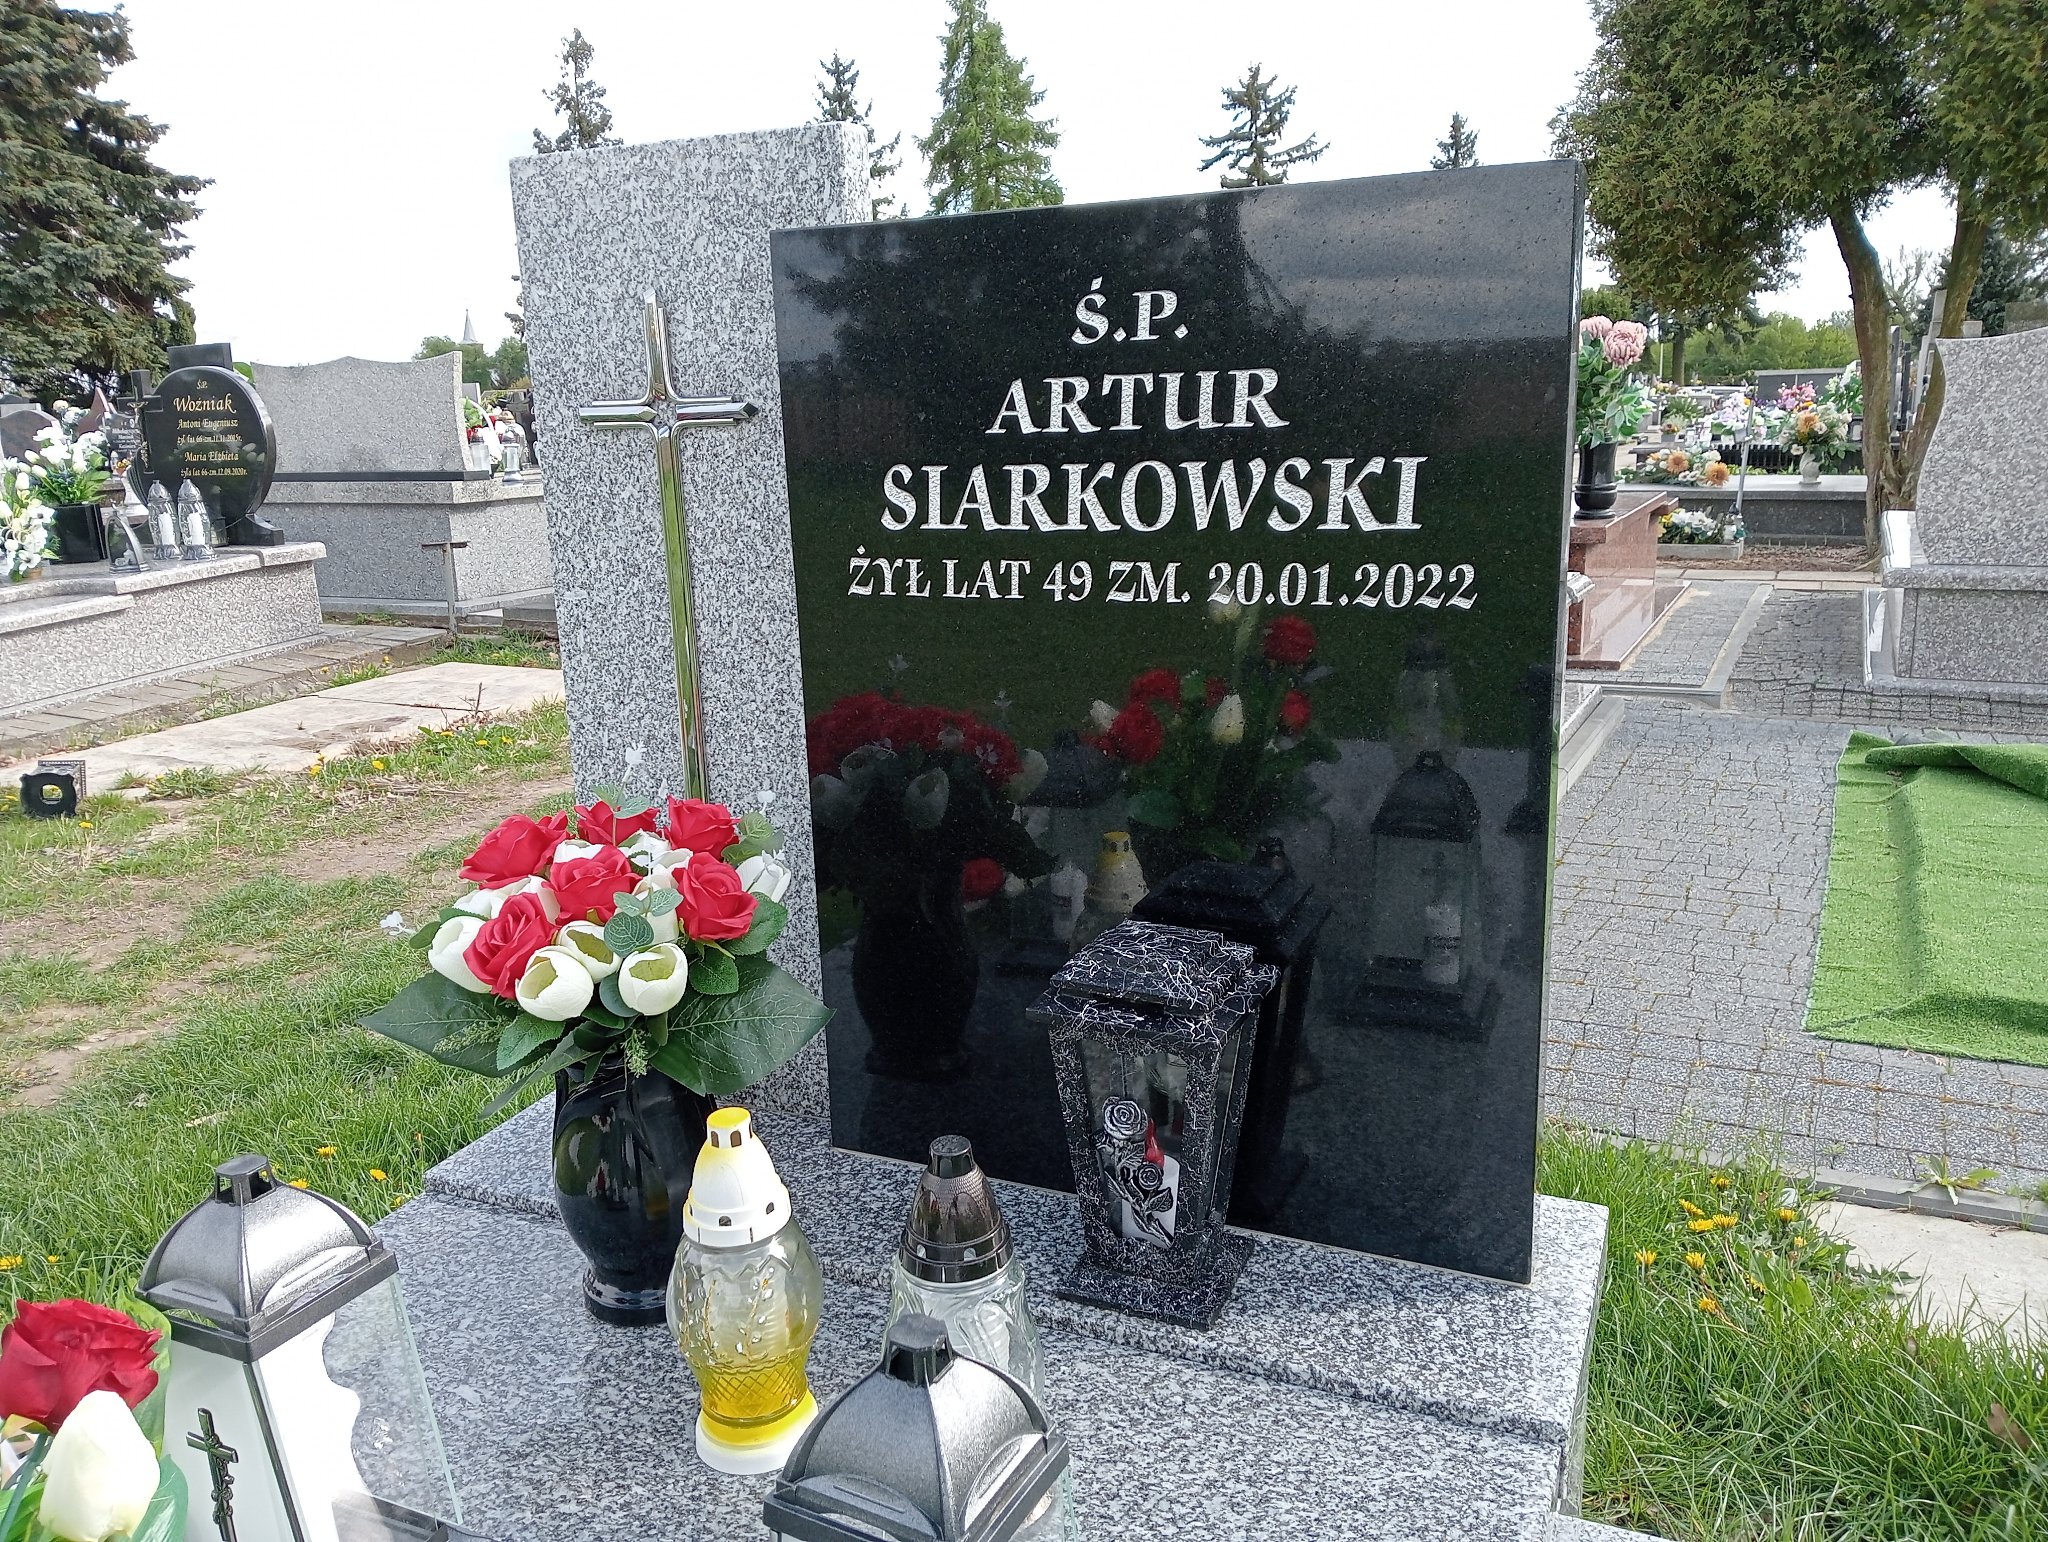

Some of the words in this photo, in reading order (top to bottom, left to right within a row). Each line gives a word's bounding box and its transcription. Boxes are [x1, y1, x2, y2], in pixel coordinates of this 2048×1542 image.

[1072, 276, 1189, 344] Ś.P.
[173, 393, 237, 413] Woźniak
[177, 418, 201, 430] Antoni
[202, 418, 238, 431] Eugeniusz
[985, 368, 1290, 435] ARTUR
[184, 451, 206, 462] Maria
[880, 456, 1429, 532] SIARKOWSKI
[847, 546, 932, 599] ŻYŁ
[943, 559, 1031, 600] LAT
[1042, 560, 1093, 603] 49
[1105, 561, 1191, 604] ZM.
[1207, 562, 1479, 609] 20.01.2022
